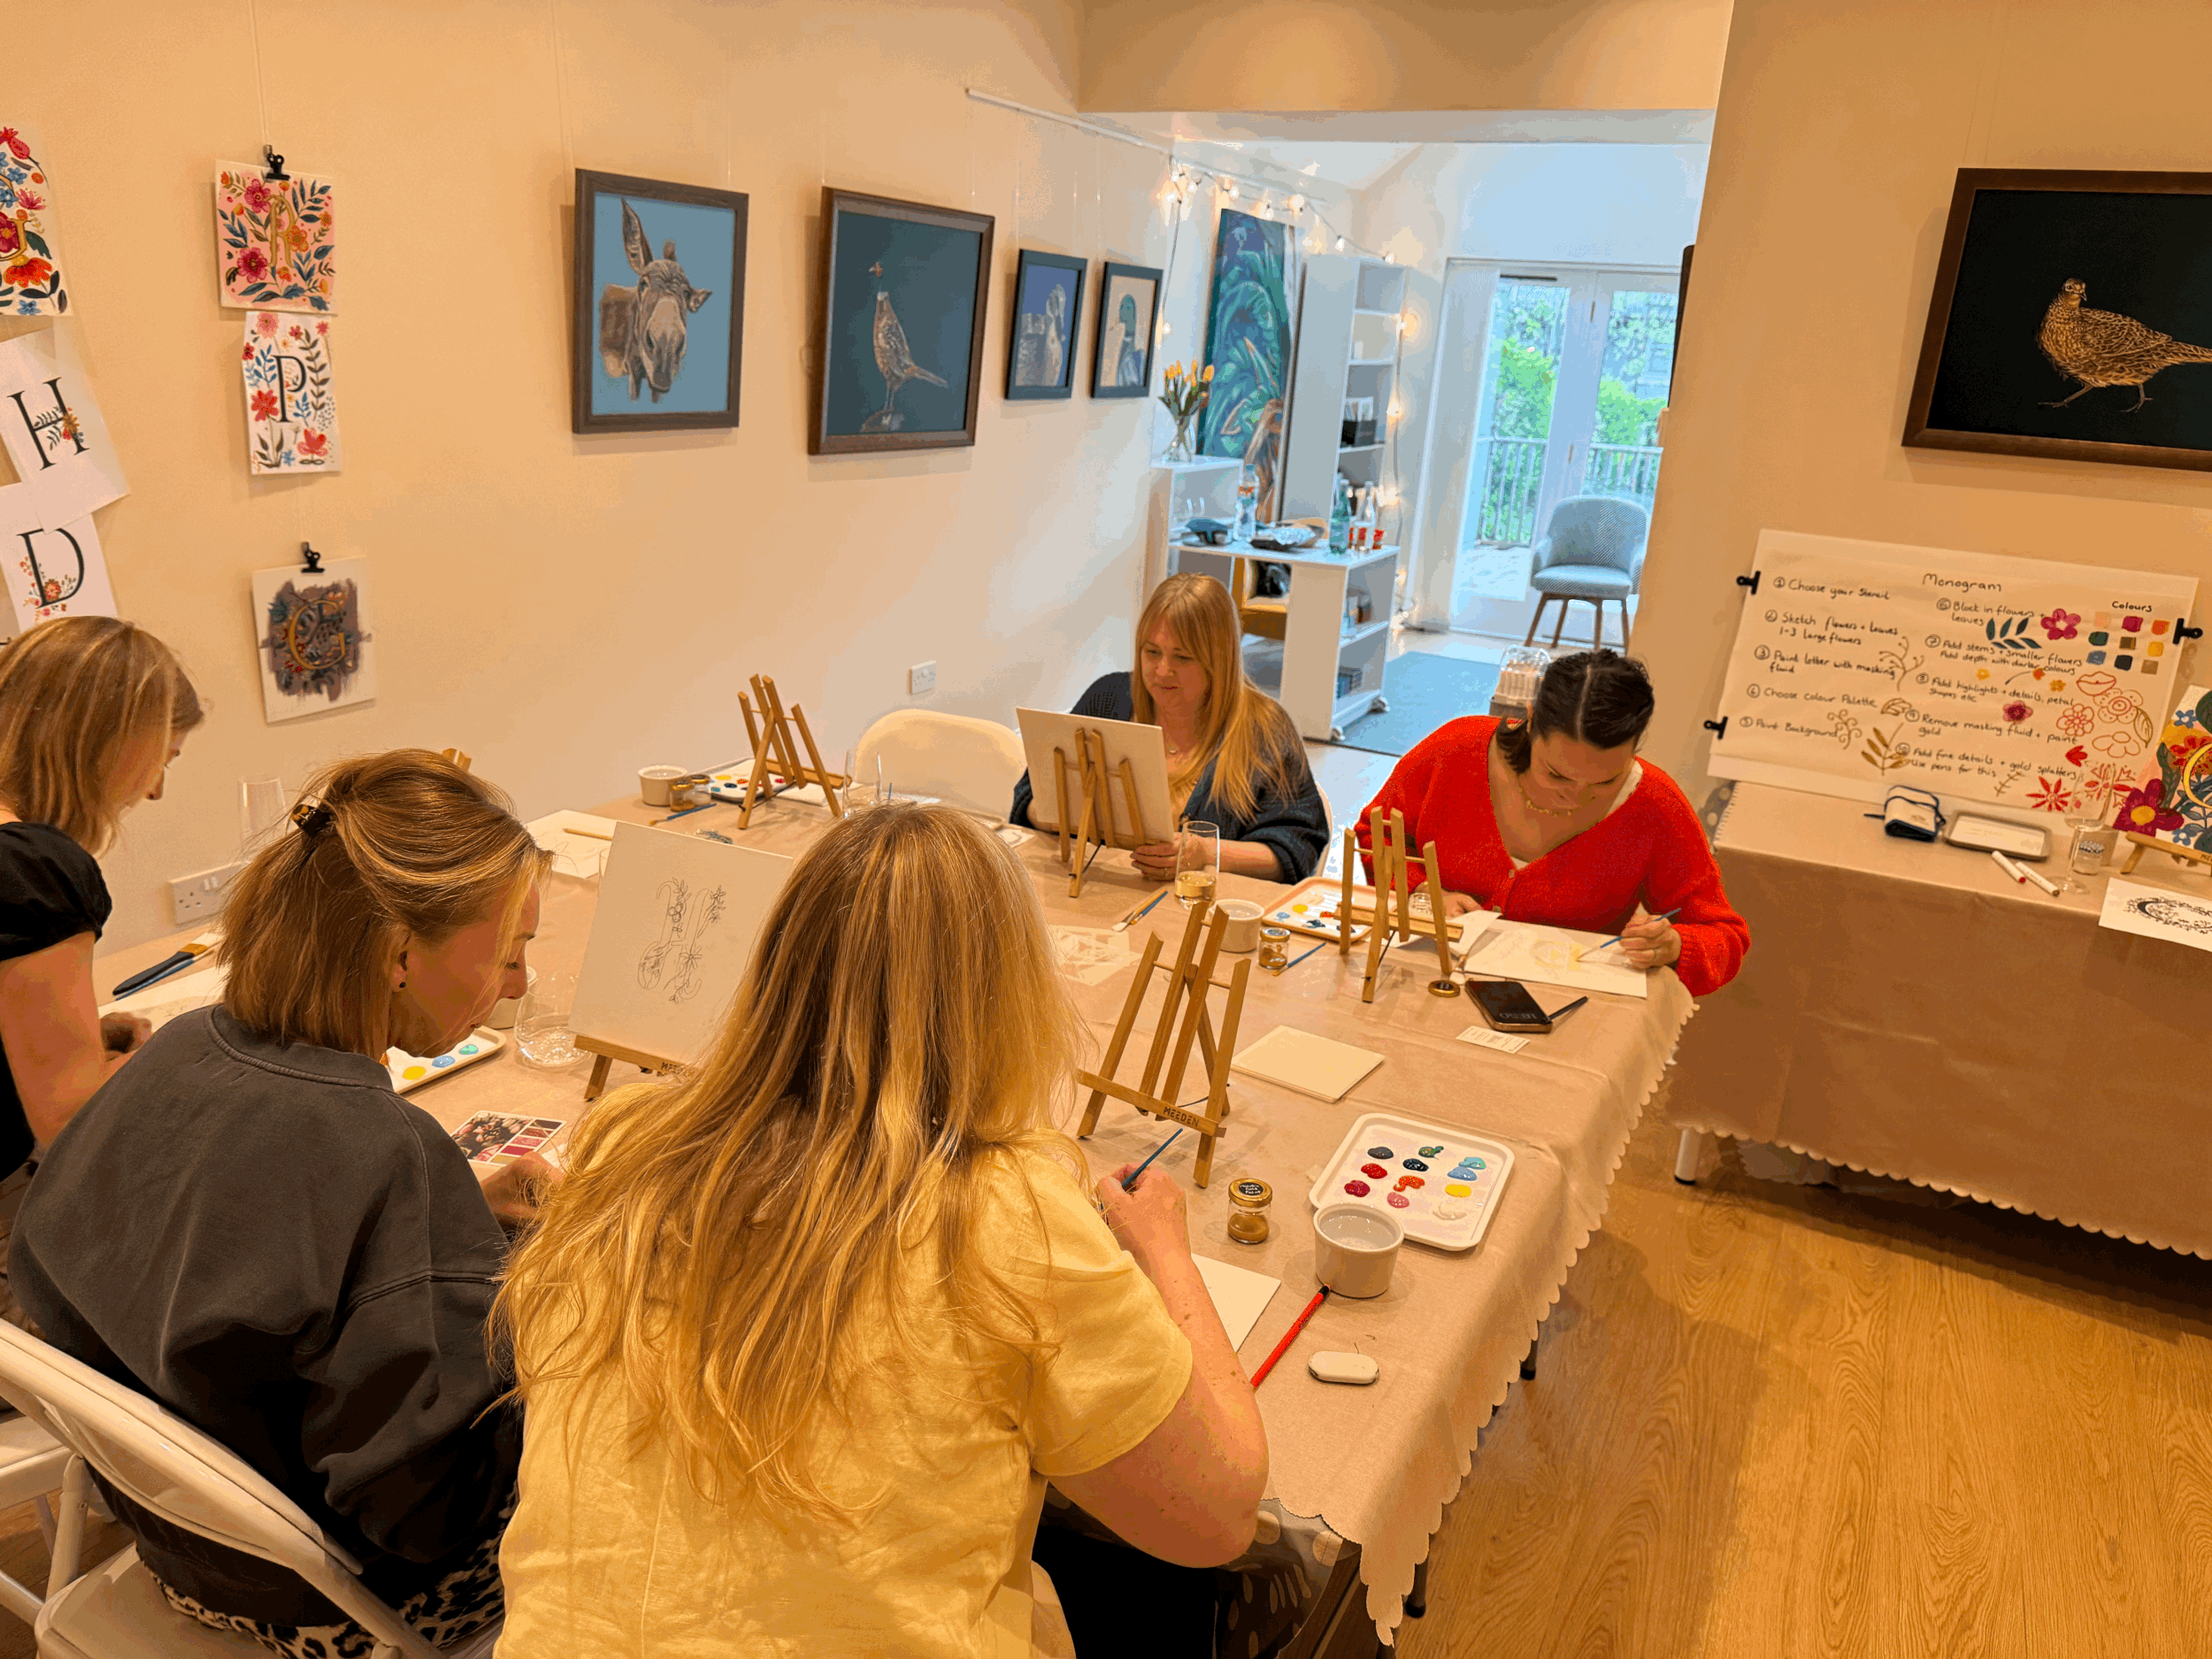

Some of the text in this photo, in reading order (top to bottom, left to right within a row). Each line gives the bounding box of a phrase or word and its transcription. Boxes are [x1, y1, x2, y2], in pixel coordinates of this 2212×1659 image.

[273, 354, 306, 423] P
[7, 377, 89, 470] H
[16, 528, 84, 609] D
[1788, 578, 1825, 593] Choose
[1830, 588, 1853, 599] your
[1922, 572, 2001, 593] Monogram
[1953, 601, 1978, 612] Block
[1995, 604, 2034, 618] flowers
[2111, 601, 2153, 612] Colours
[1782, 611, 1816, 626] Sketch
[1825, 616, 1857, 631] flowers
[1951, 613, 1984, 626] leaves
[1830, 633, 1862, 645] flowers
[1939, 650, 2076, 676] Add depth with darker colours
[1943, 640, 1962, 649] Add
[1965, 641, 1995, 655] stems
[2006, 648, 2044, 661] smaller
[2047, 653, 2082, 667] flowers
[1770, 661, 1794, 673] fluid
[1774, 649, 1799, 663] Paint
[1804, 653, 1830, 666] letter
[1833, 660, 1853, 669] with
[1856, 664, 1895, 680] masking
[1764, 687, 1797, 700] Choose
[1804, 693, 1836, 703] colour
[1841, 694, 1878, 709] Palette
[1932, 676, 1952, 687] Add
[1956, 680, 1997, 696] highlights
[2047, 696, 2074, 708] petal
[1961, 694, 1977, 703] etc
[1756, 718, 1778, 730] Paint
[1785, 723, 1838, 738] Background
[1922, 714, 1958, 727] Remove
[1964, 721, 2002, 736] masking
[2008, 723, 2032, 737] fluid
[2047, 733, 2078, 745] paint
[1910, 759, 1996, 778] Use pens for this
[1913, 748, 1932, 758] Add
[1936, 749, 1954, 761] fine
[1958, 753, 1993, 765] details
[2009, 761, 2032, 772] gold
[2037, 766, 2077, 780] splatters
[1163, 1106, 1200, 1127] MEEDEN
